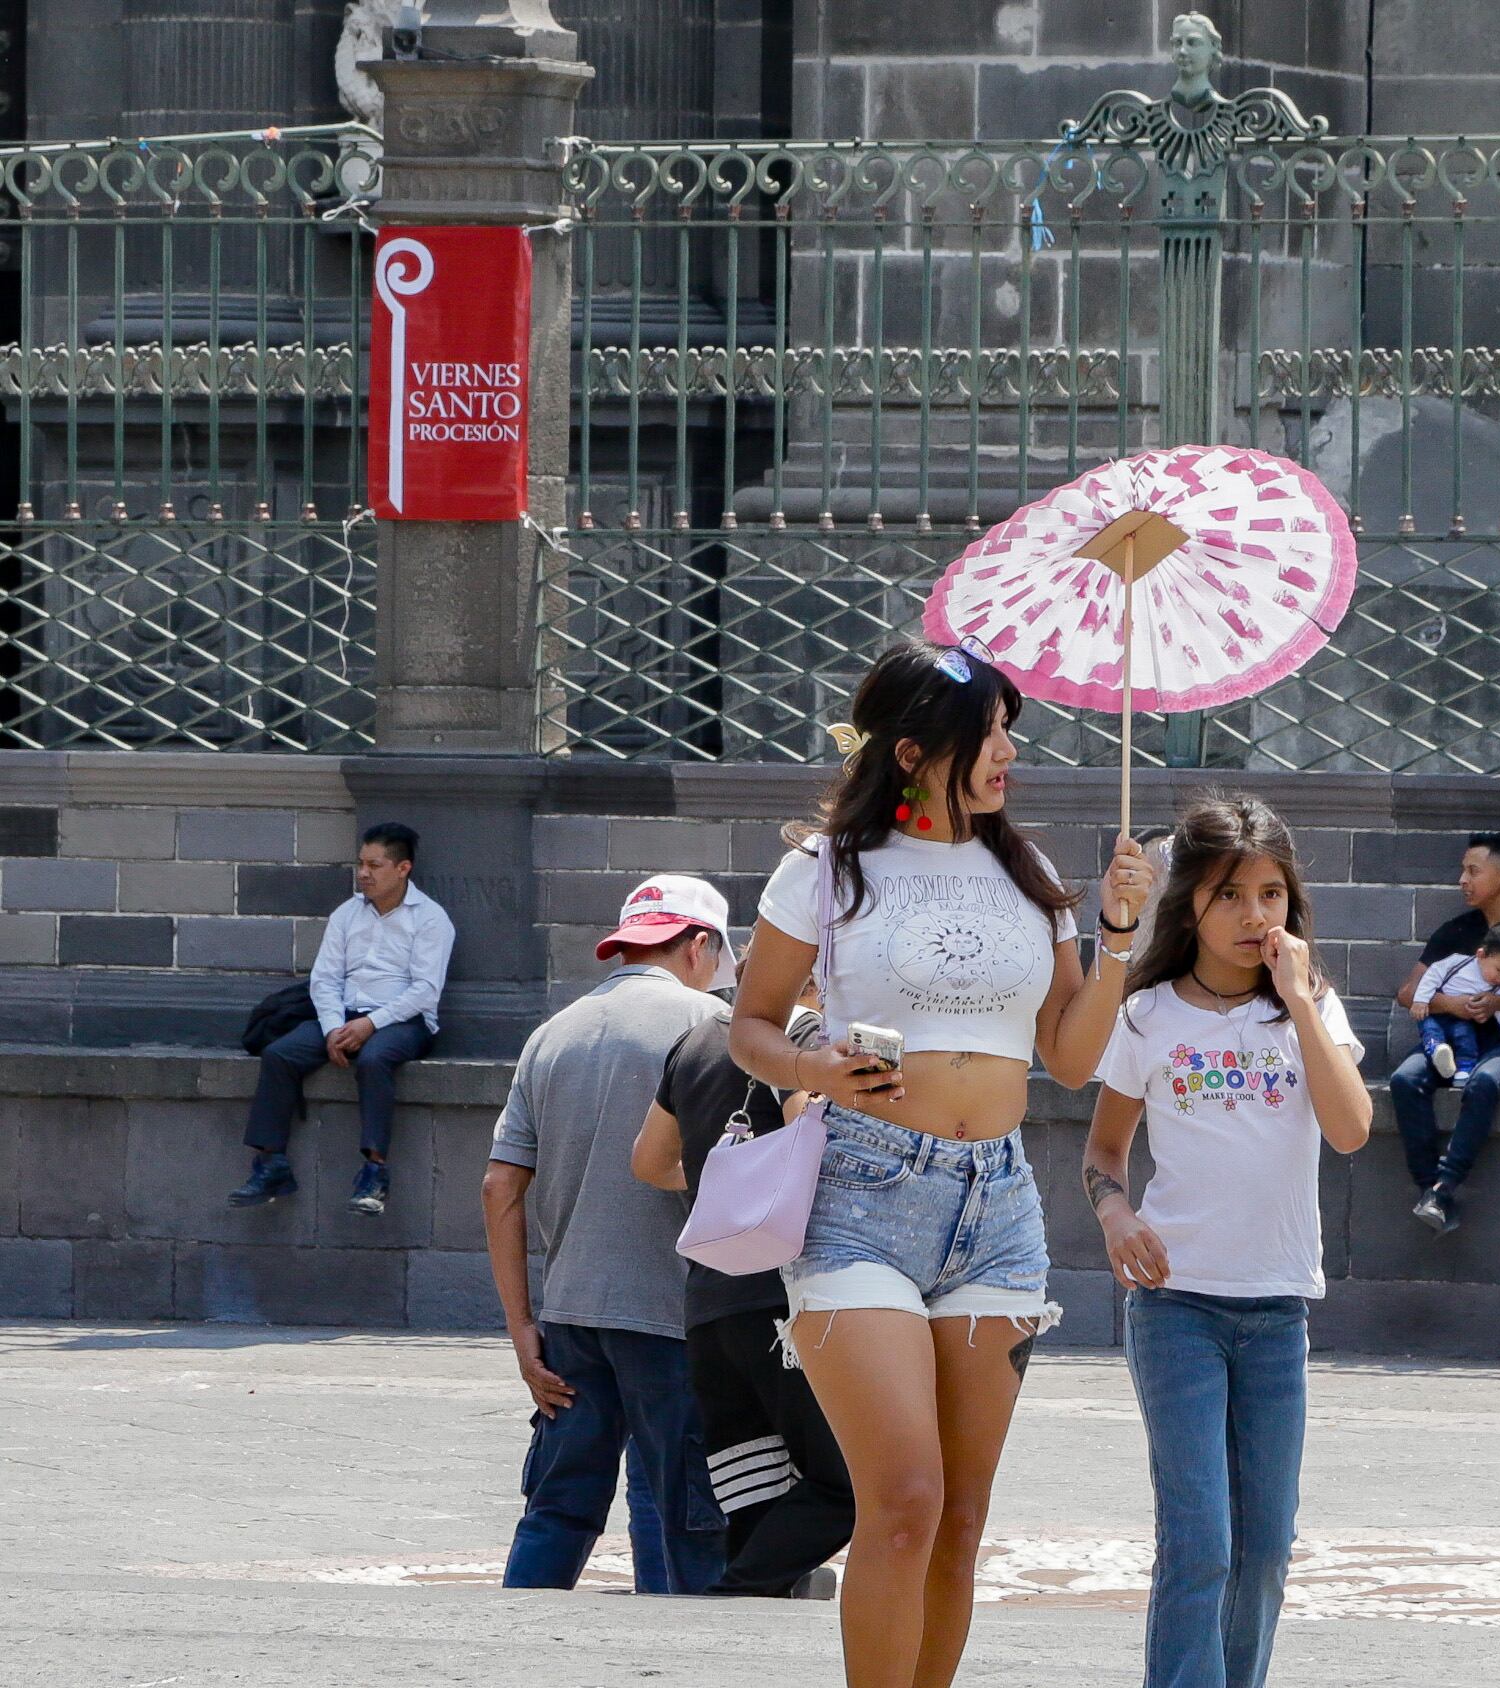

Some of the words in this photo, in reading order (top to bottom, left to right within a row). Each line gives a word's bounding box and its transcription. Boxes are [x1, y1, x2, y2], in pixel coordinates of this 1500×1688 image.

[411, 363, 521, 387] VIERNES
[409, 391, 521, 418] SANTO
[409, 420, 519, 441] PROCESIÓN
[879, 875, 965, 919] COSMIC
[968, 876, 1022, 921] TRIP
[899, 987, 922, 999] FOR
[1190, 1050, 1254, 1071] STAY
[1172, 1070, 1279, 1095] GROOVY
[1202, 1092, 1225, 1101] MAKE
[1235, 1093, 1256, 1101] COOL
